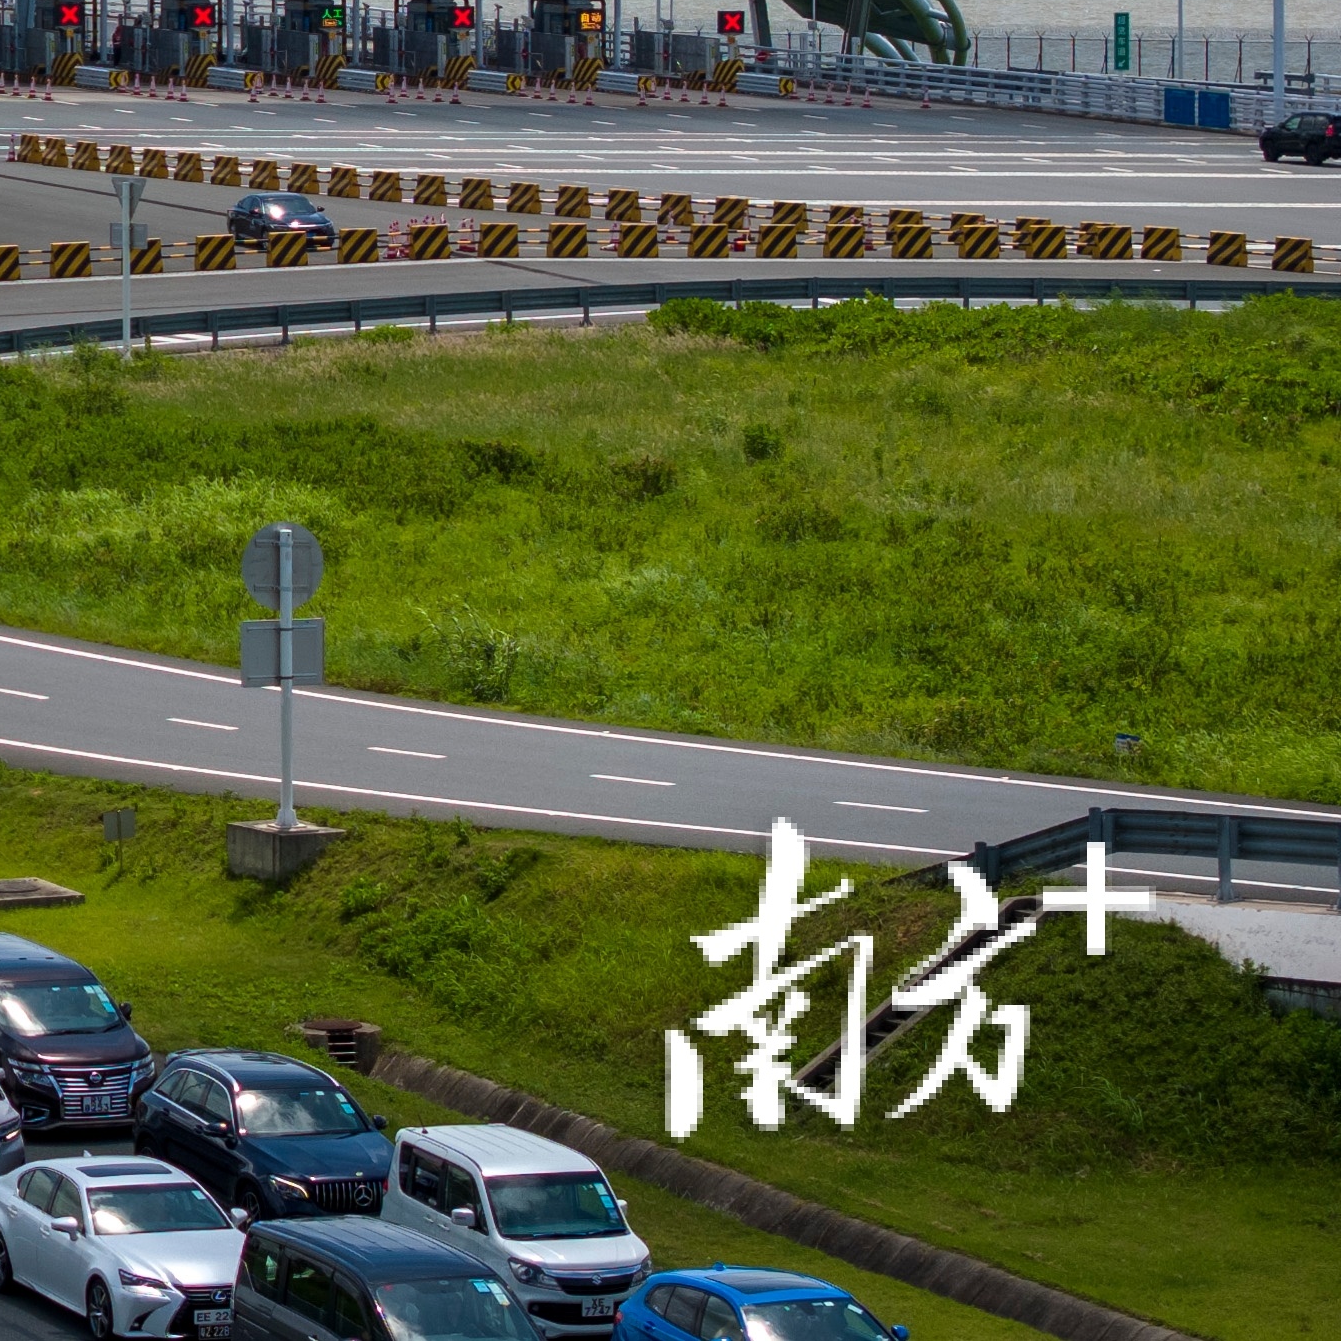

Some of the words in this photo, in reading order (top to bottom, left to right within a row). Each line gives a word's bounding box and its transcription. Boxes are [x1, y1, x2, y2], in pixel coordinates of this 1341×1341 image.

[322, 9, 343, 19] 人工
[591, 1298, 604, 1307] XE
[196, 1311, 211, 1322] EE
